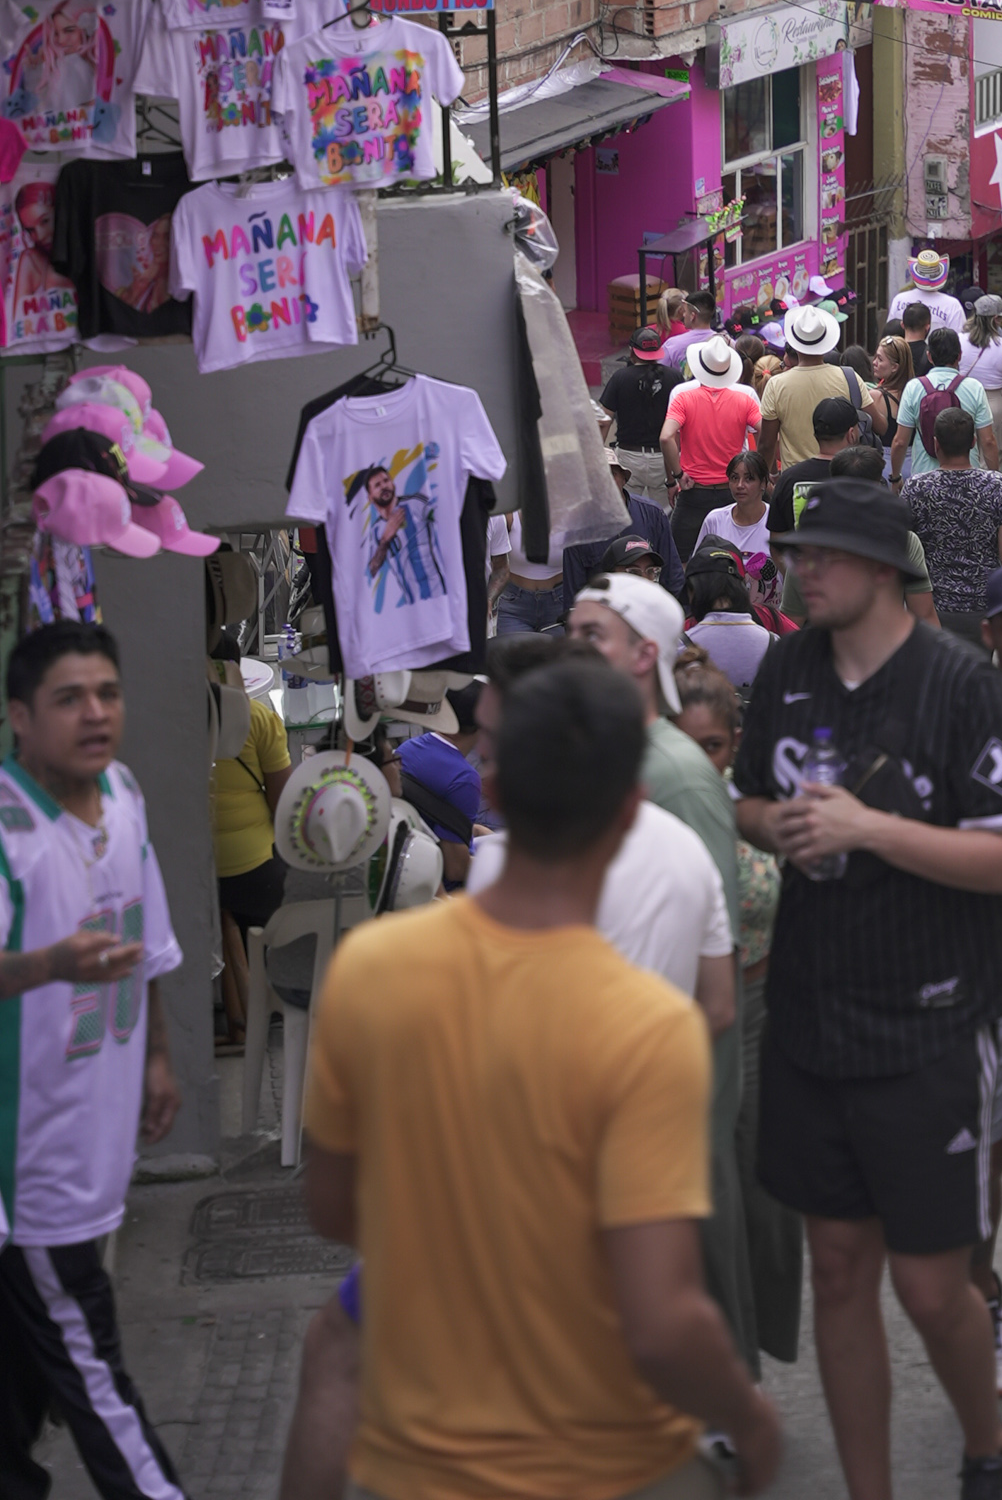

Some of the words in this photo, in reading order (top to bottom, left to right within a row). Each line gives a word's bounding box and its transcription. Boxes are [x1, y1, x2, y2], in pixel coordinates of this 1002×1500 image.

[307, 64, 422, 112] MAÑANA
[334, 97, 402, 139] SERÁ
[202, 210, 337, 269] MAÑANA
